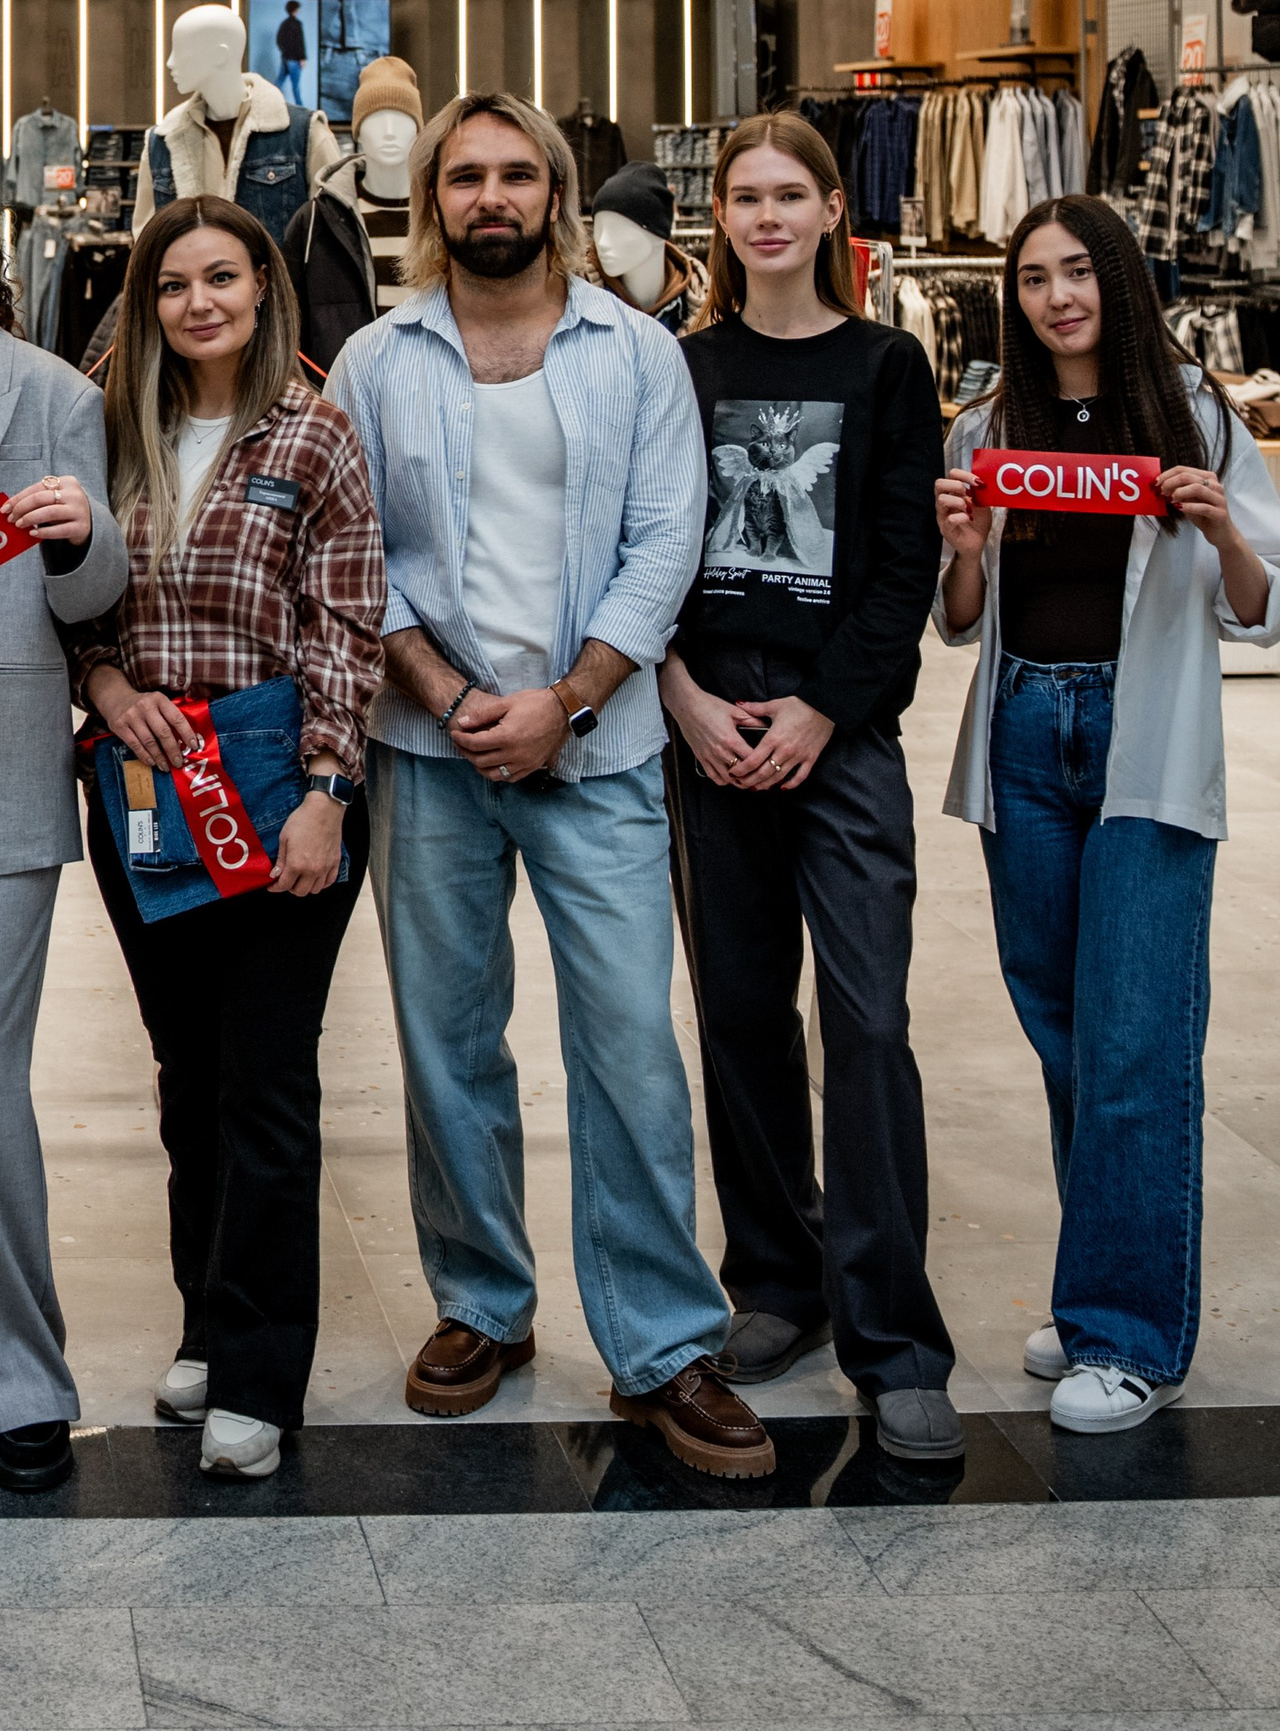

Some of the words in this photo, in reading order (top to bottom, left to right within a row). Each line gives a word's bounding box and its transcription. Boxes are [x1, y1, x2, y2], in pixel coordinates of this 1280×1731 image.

[995, 462, 1140, 502] COLIN'S
[761, 573, 794, 584] PARTY
[794, 576, 832, 588] ANIMAL
[178, 732, 250, 870] COLINS
